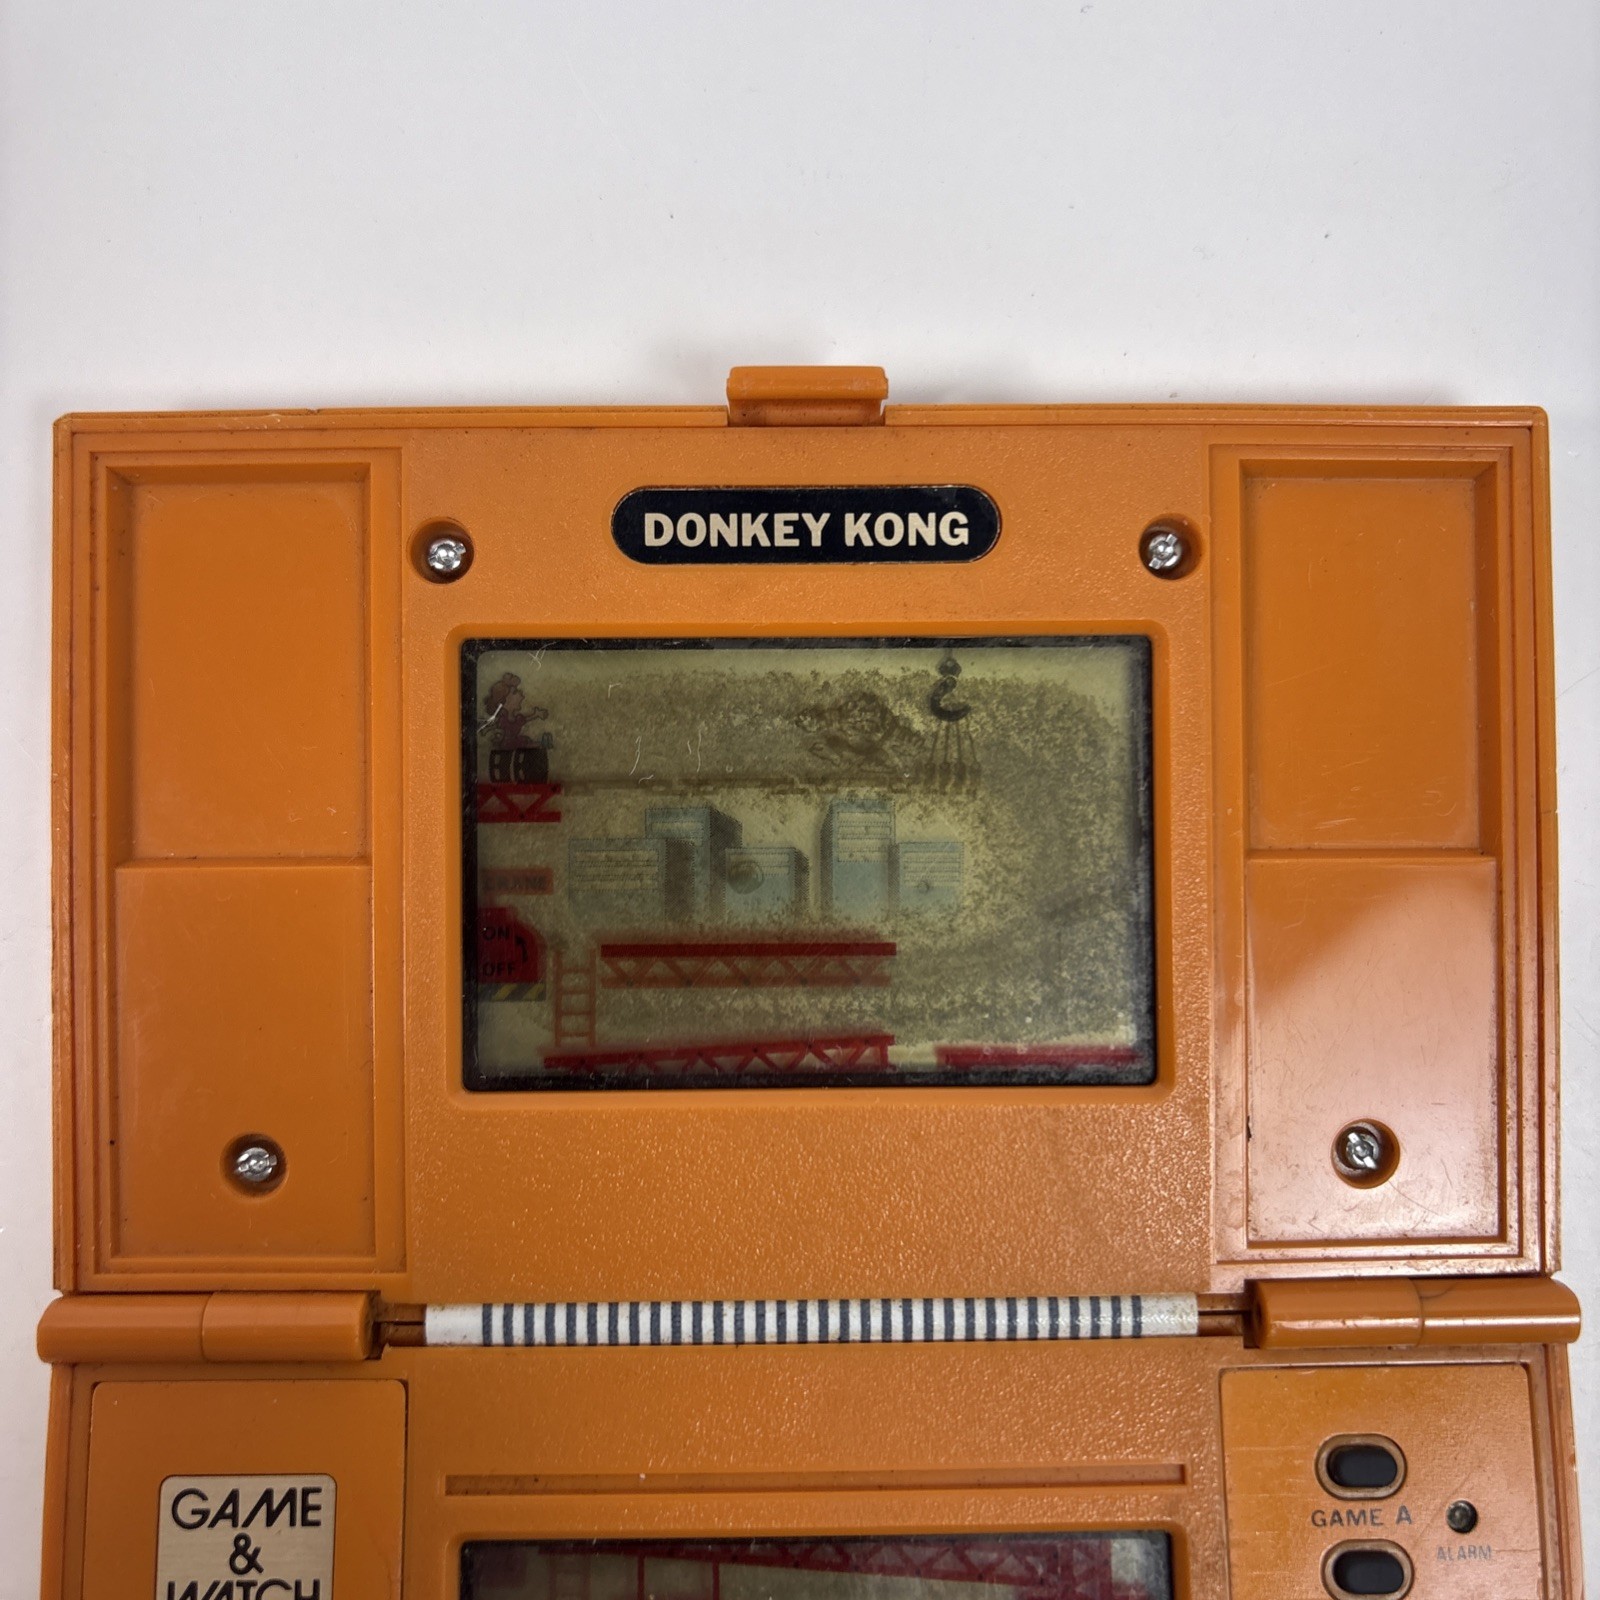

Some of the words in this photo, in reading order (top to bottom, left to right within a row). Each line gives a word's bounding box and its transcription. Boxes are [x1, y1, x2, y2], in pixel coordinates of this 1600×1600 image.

[644, 512, 830, 547] DONKEY
[844, 511, 969, 547] KONG
[483, 926, 510, 941] ON
[483, 962, 515, 977] OFF
[171, 1486, 323, 1530] GAME
[1311, 1508, 1384, 1528] GAME
[1395, 1505, 1413, 1525] A
[229, 1532, 265, 1575] &
[1436, 1545, 1492, 1561] ALARM
